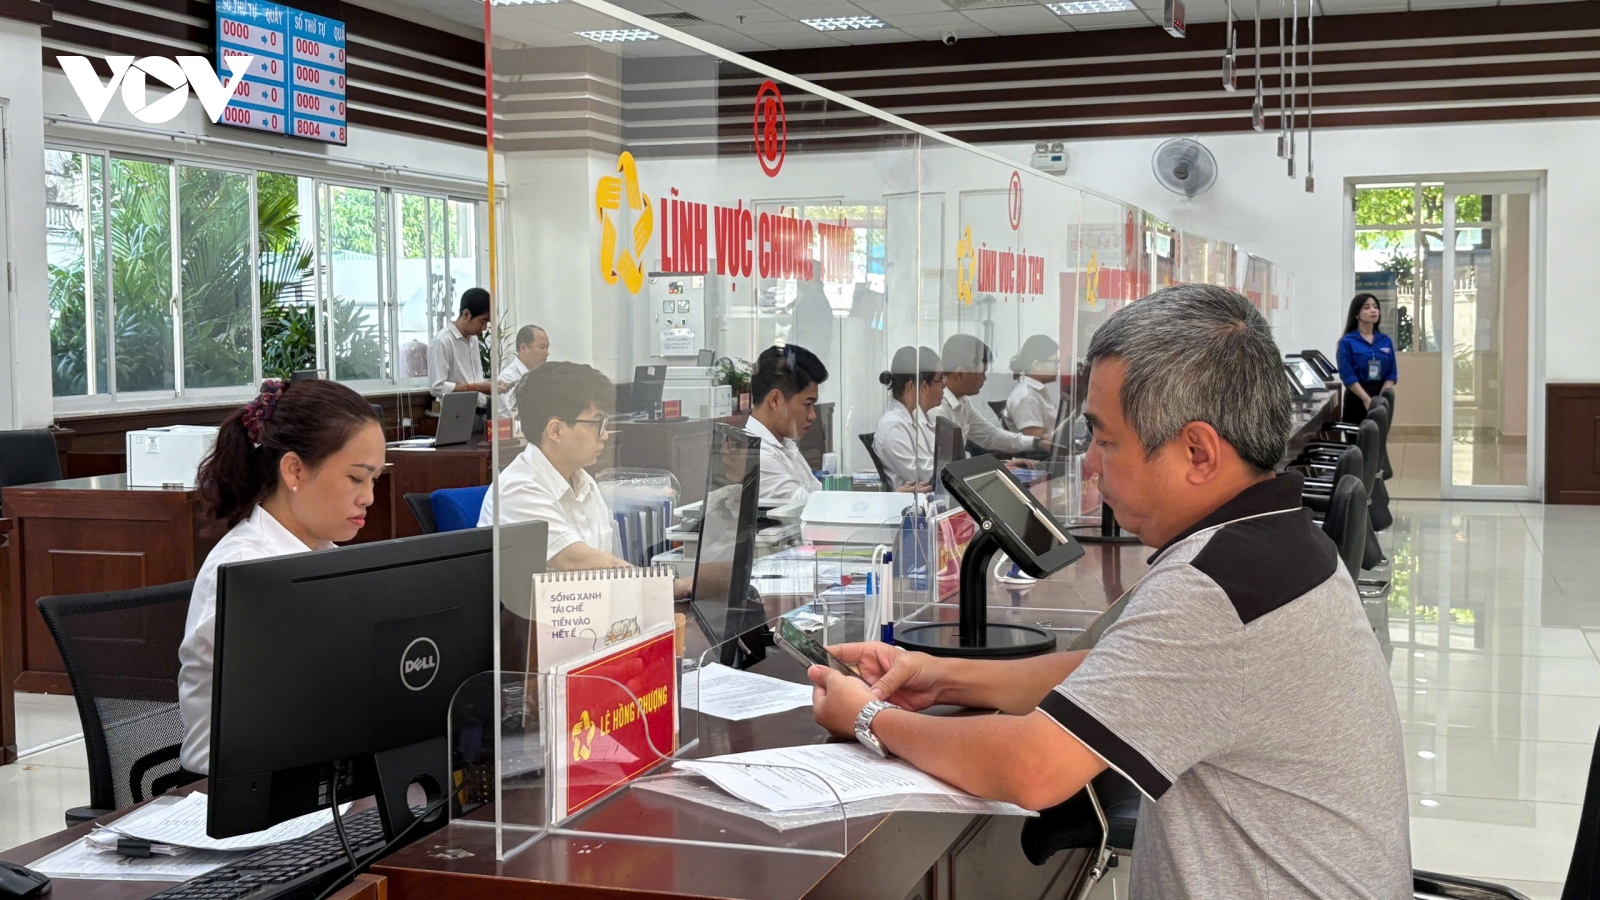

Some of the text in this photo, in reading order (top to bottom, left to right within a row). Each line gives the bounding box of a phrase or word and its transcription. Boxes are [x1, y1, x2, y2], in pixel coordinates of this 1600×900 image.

[223, 19, 277, 47] 0000 0
[294, 13, 304, 31] SỐ
[296, 38, 344, 63] 0000 0
[271, 59, 277, 75] 0
[296, 65, 345, 89] 0000 0
[271, 87, 278, 102] 0
[297, 92, 345, 116] 0000 0
[225, 106, 278, 130] 0000 0
[764, 96, 777, 161] 8
[297, 119, 345, 141] 8004 8
[660, 187, 708, 275] LĨNH
[714, 199, 753, 293] VỰC
[759, 205, 813, 282] CHỨNG
[550, 591, 602, 603] SỐNG XANH
[551, 602, 584, 614] TÁI CHẾ
[572, 616, 591, 626] VÀO
[551, 628, 577, 639] HẾT Ế
[405, 655, 435, 673] DELL
[600, 709, 611, 737] LÊ
[612, 701, 635, 731] HỒNG
[637, 685, 668, 719] PHƯỢNG
